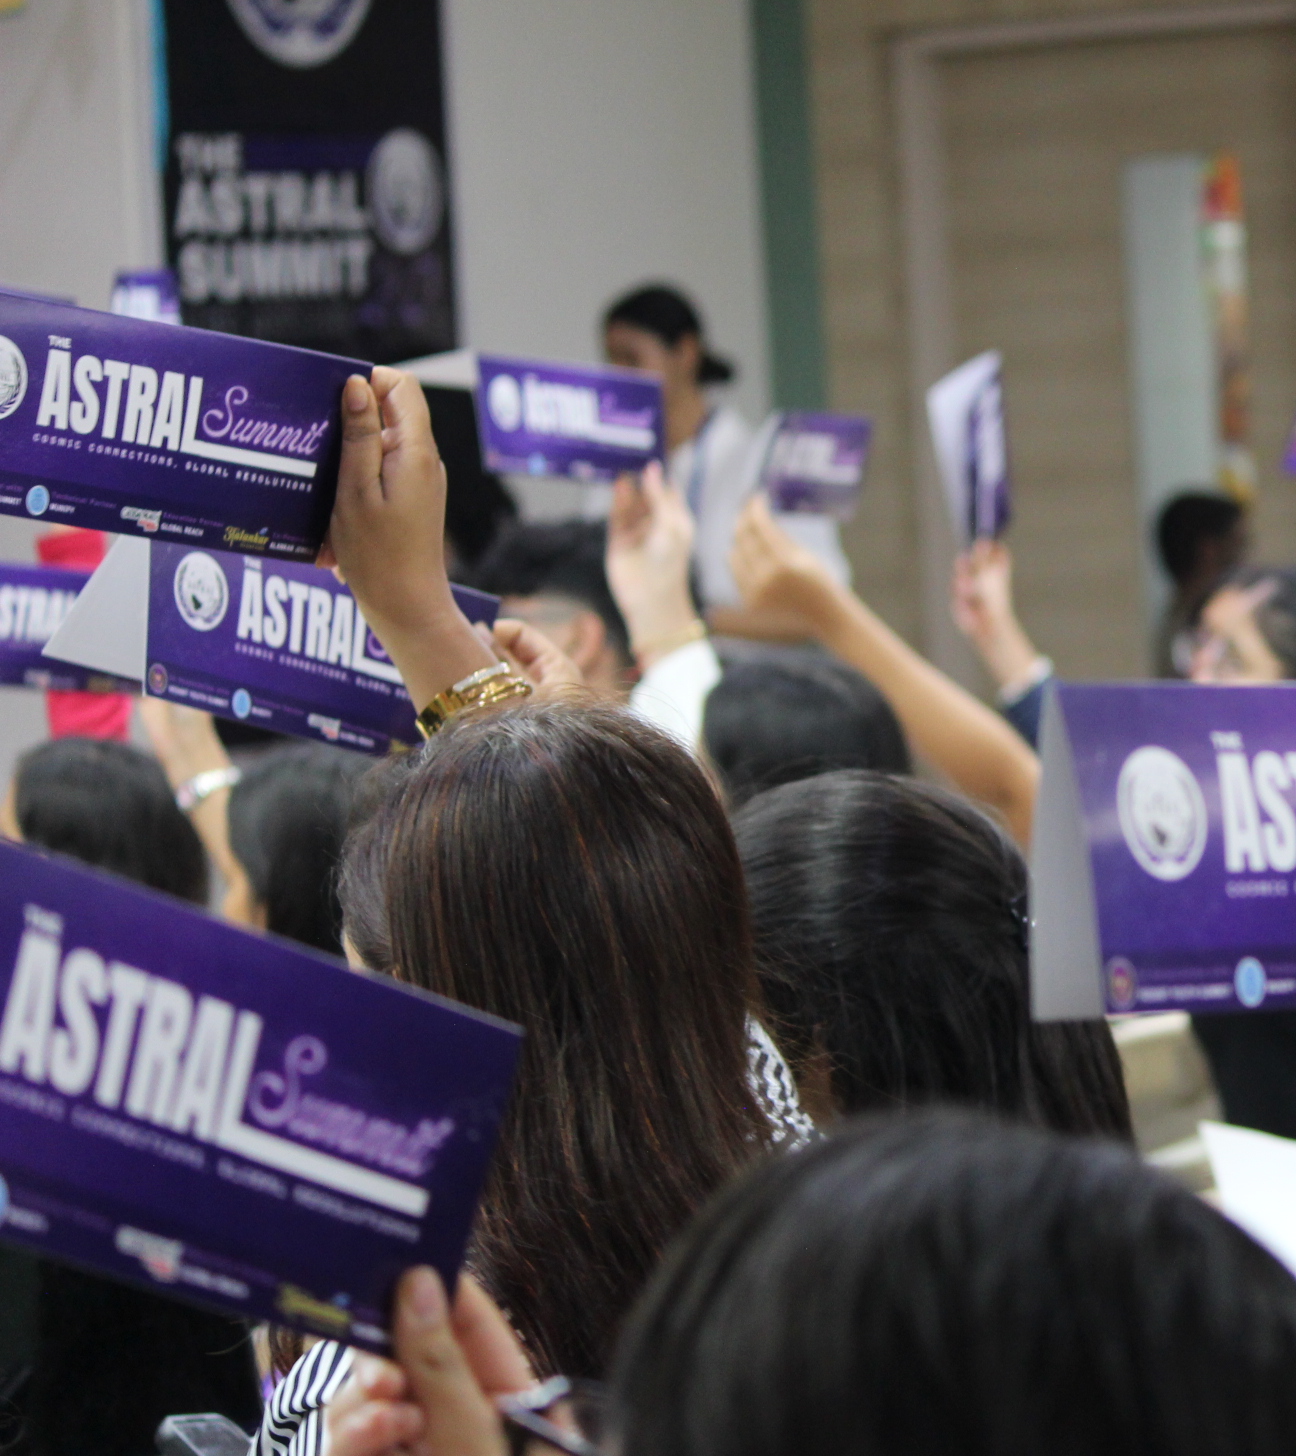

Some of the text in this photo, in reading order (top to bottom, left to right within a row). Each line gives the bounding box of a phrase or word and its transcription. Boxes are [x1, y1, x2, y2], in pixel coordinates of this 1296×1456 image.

[176, 133, 243, 171] THE
[174, 173, 368, 236] ASTRAL
[179, 240, 370, 303] SUMMIT
[48, 335, 72, 349] THE
[202, 385, 329, 456] Summit
[32, 433, 81, 450] COSMIC
[185, 460, 229, 478] GLOBAL
[235, 469, 313, 493] RESOLUTIONS
[249, 1034, 455, 1178] Summit
